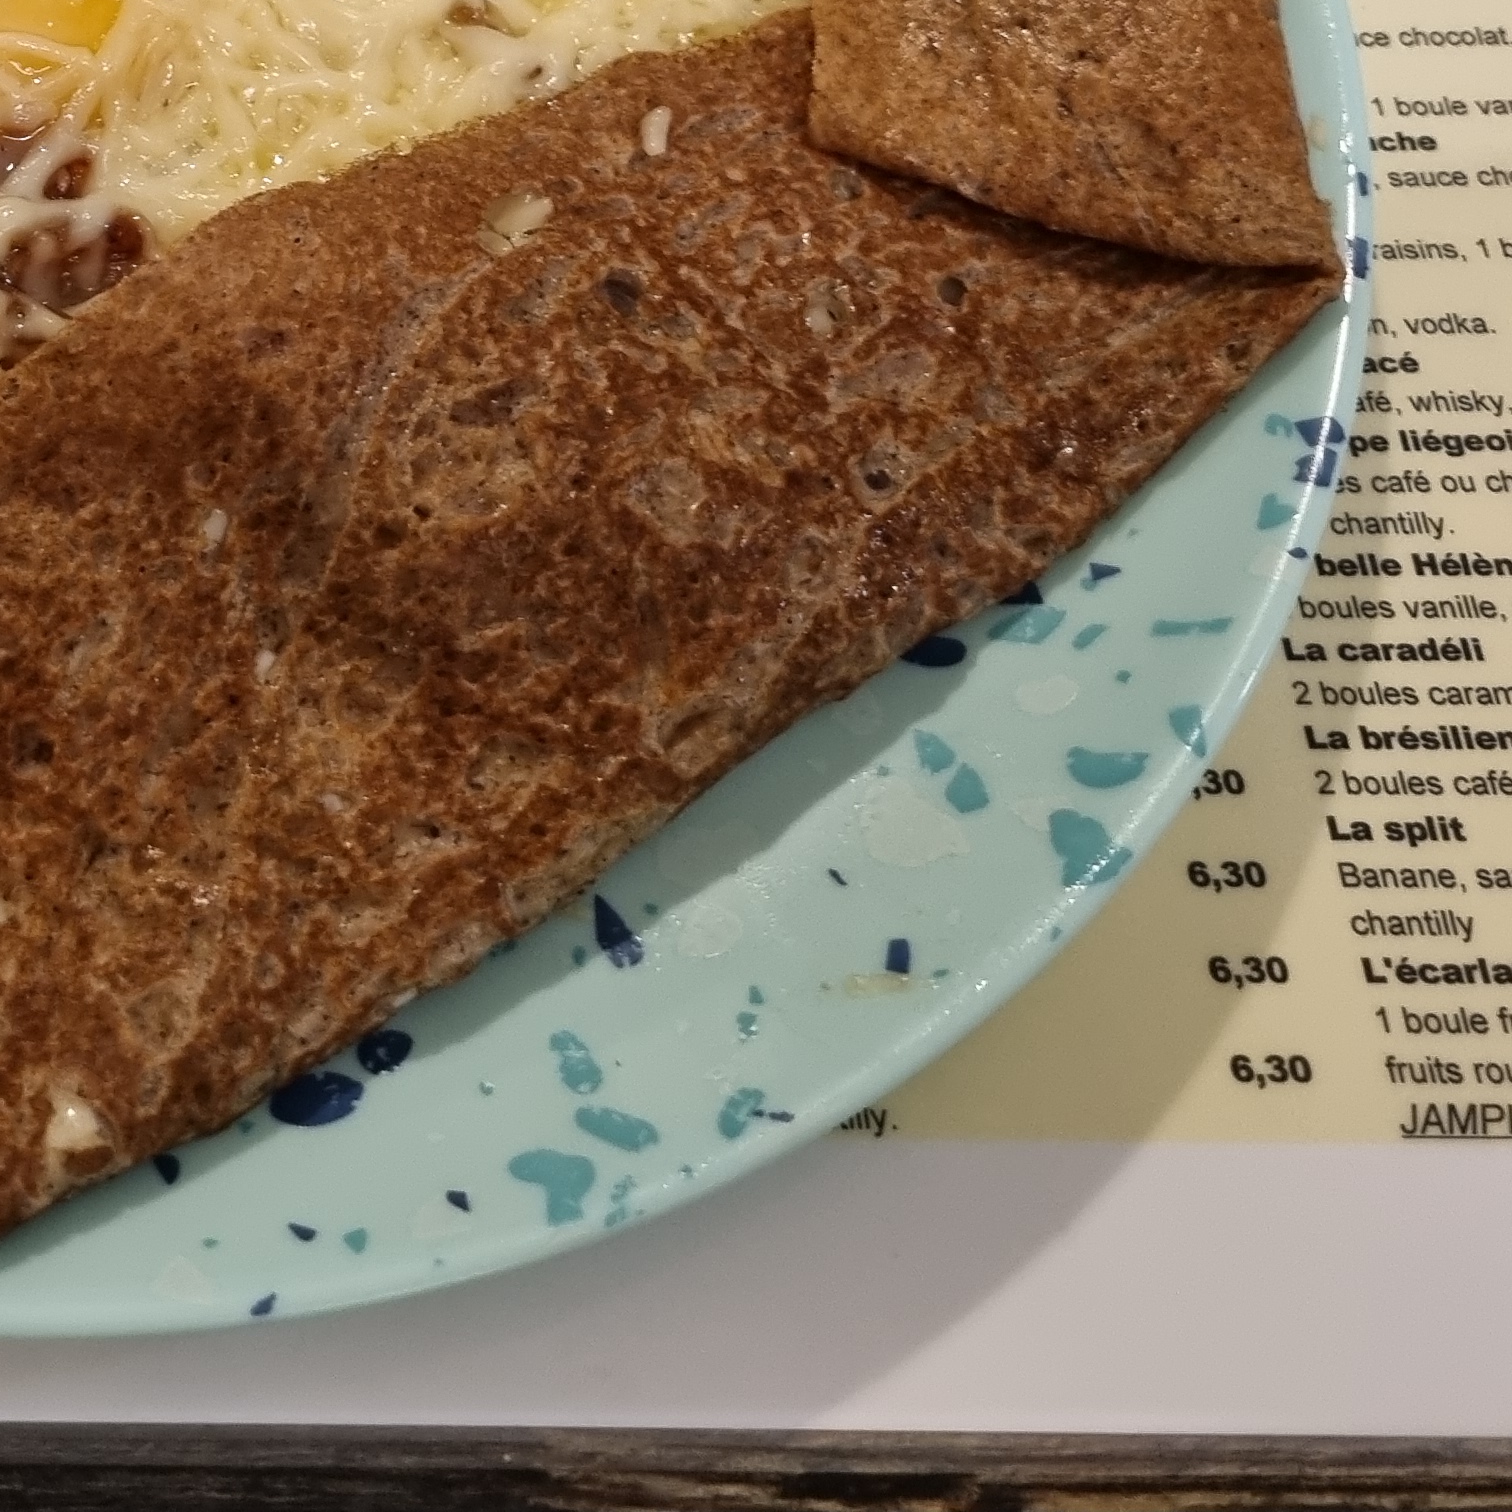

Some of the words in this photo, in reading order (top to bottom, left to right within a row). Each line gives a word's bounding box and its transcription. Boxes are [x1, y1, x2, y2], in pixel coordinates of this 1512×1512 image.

[1371, 97, 1384, 116] 1
[1393, 96, 1468, 116] boule
[1388, 171, 1468, 187] sauce
[1372, 240, 1467, 261] raisins,
[1476, 239, 1489, 258] 1
[1403, 313, 1496, 334] vodka.
[1369, 470, 1431, 494] café
[1440, 475, 1476, 493] ou
[1314, 553, 1402, 577] belle
[1297, 595, 1395, 620] boules
[1402, 595, 1507, 622] vanille,
[1282, 638, 1327, 662] La
[1336, 637, 1484, 662] caradéli
[1292, 681, 1313, 705] 2
[1318, 681, 1419, 706] boules
[1303, 725, 1350, 750] La
[1314, 770, 1335, 795] 2
[1342, 770, 1444, 795] boules
[1453, 770, 1512, 795] café
[1326, 816, 1374, 841] La
[1384, 816, 1467, 847] split
[1187, 861, 1267, 893] 6,30
[1337, 862, 1466, 892] Banane,
[1350, 910, 1473, 943] chantilly
[1207, 955, 1289, 990] 6,30
[1375, 1007, 1390, 1033] 1
[1401, 1007, 1490, 1035] boule
[1230, 1055, 1312, 1089] 6,30
[1385, 1055, 1464, 1084] fruits
